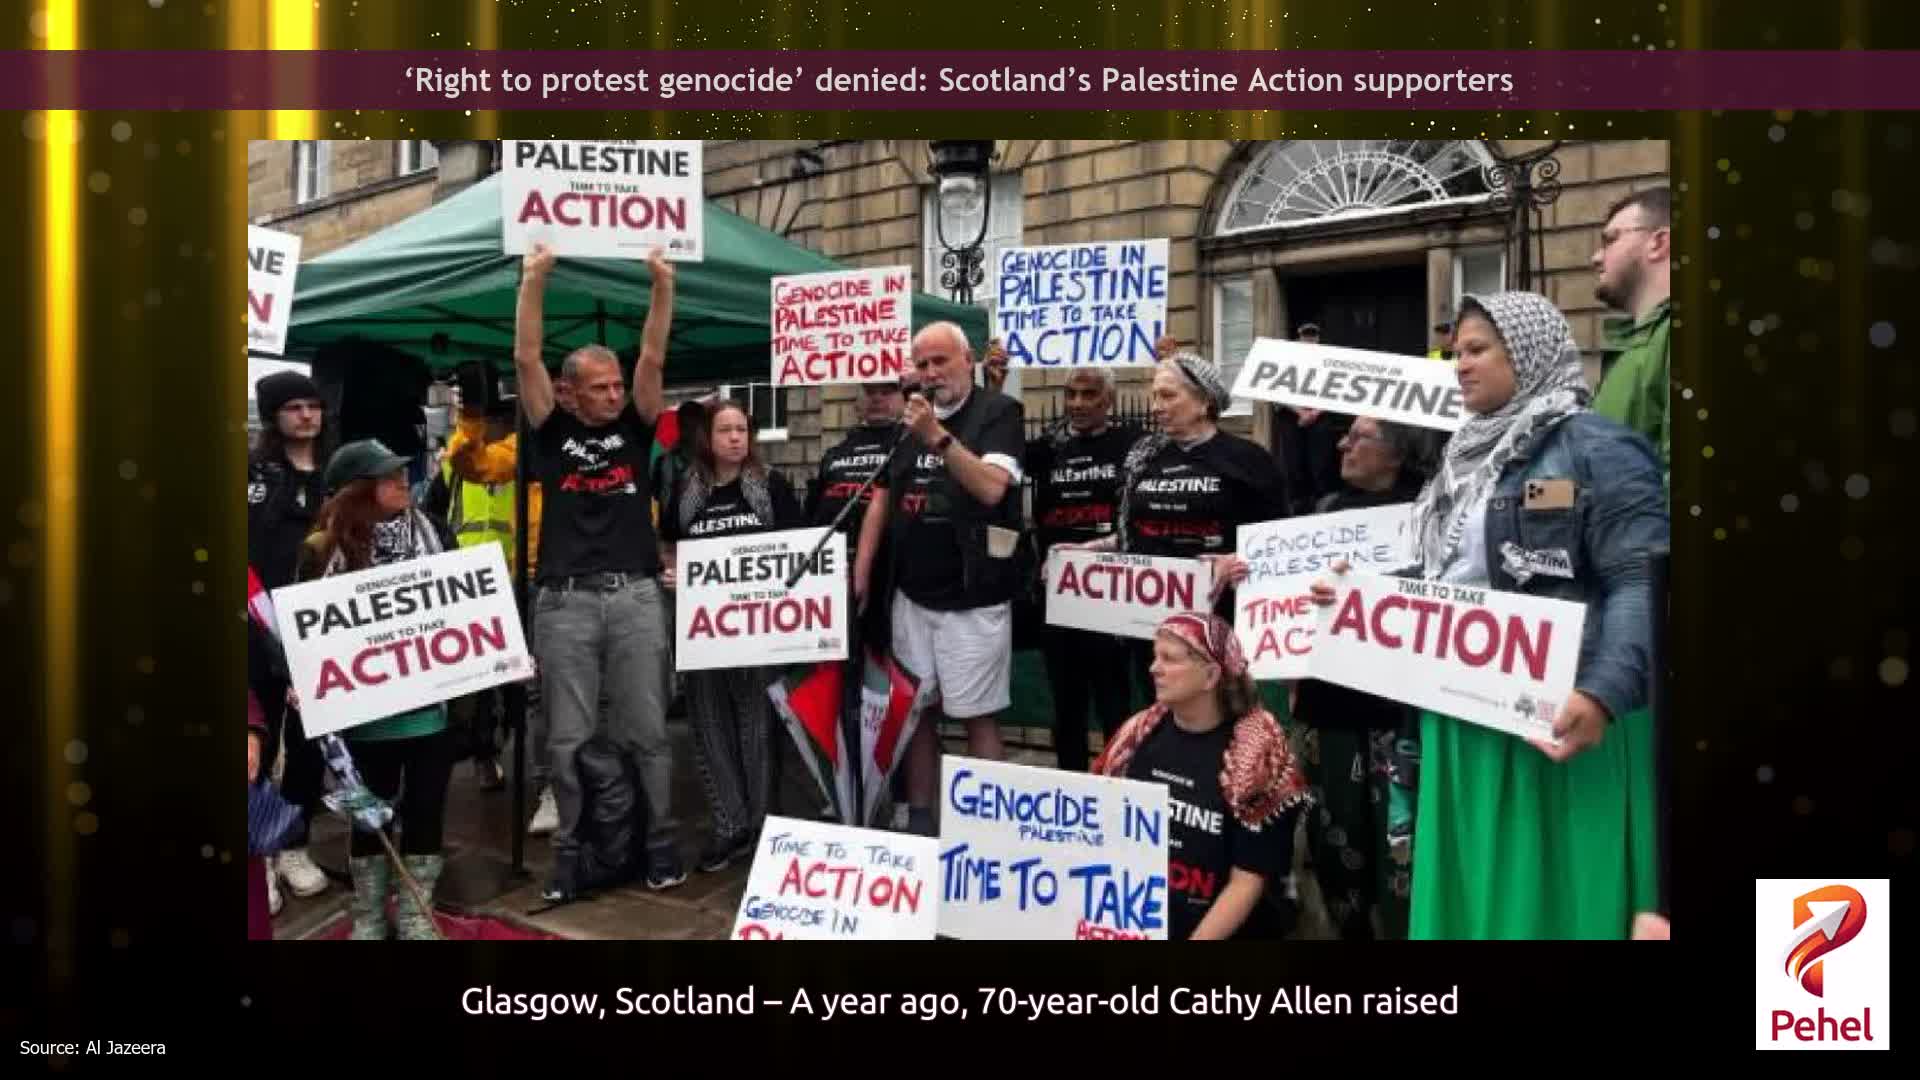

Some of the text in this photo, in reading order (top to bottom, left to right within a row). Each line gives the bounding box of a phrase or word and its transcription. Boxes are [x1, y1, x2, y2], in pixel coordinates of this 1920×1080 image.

[515, 141, 689, 177] PALESTINE
[518, 190, 687, 230] ACTION
[1002, 245, 1145, 274] GENOCIDE IN
[775, 276, 905, 305] GENOCIDE IN
[1000, 265, 1166, 308] PALESTINE
[775, 298, 896, 333] PALESTINE
[998, 303, 1136, 330] TIME TO TAKE
[773, 328, 908, 355] TIME TO TAKE
[1006, 320, 1163, 366] ACTION
[779, 349, 903, 384] ACTION
[1250, 361, 1464, 419] PALESTINE
[687, 548, 834, 586] PALESTINE
[1057, 562, 1195, 610] ACTION
[294, 568, 497, 640] PALESTINE
[688, 597, 832, 639] ACTION
[1243, 595, 1315, 628] TIME
[1255, 627, 1316, 661] AC
[1330, 588, 1553, 682] ACTION
[315, 616, 507, 700] ACTION
[939, 843, 1167, 929] TIME TO TAKE
